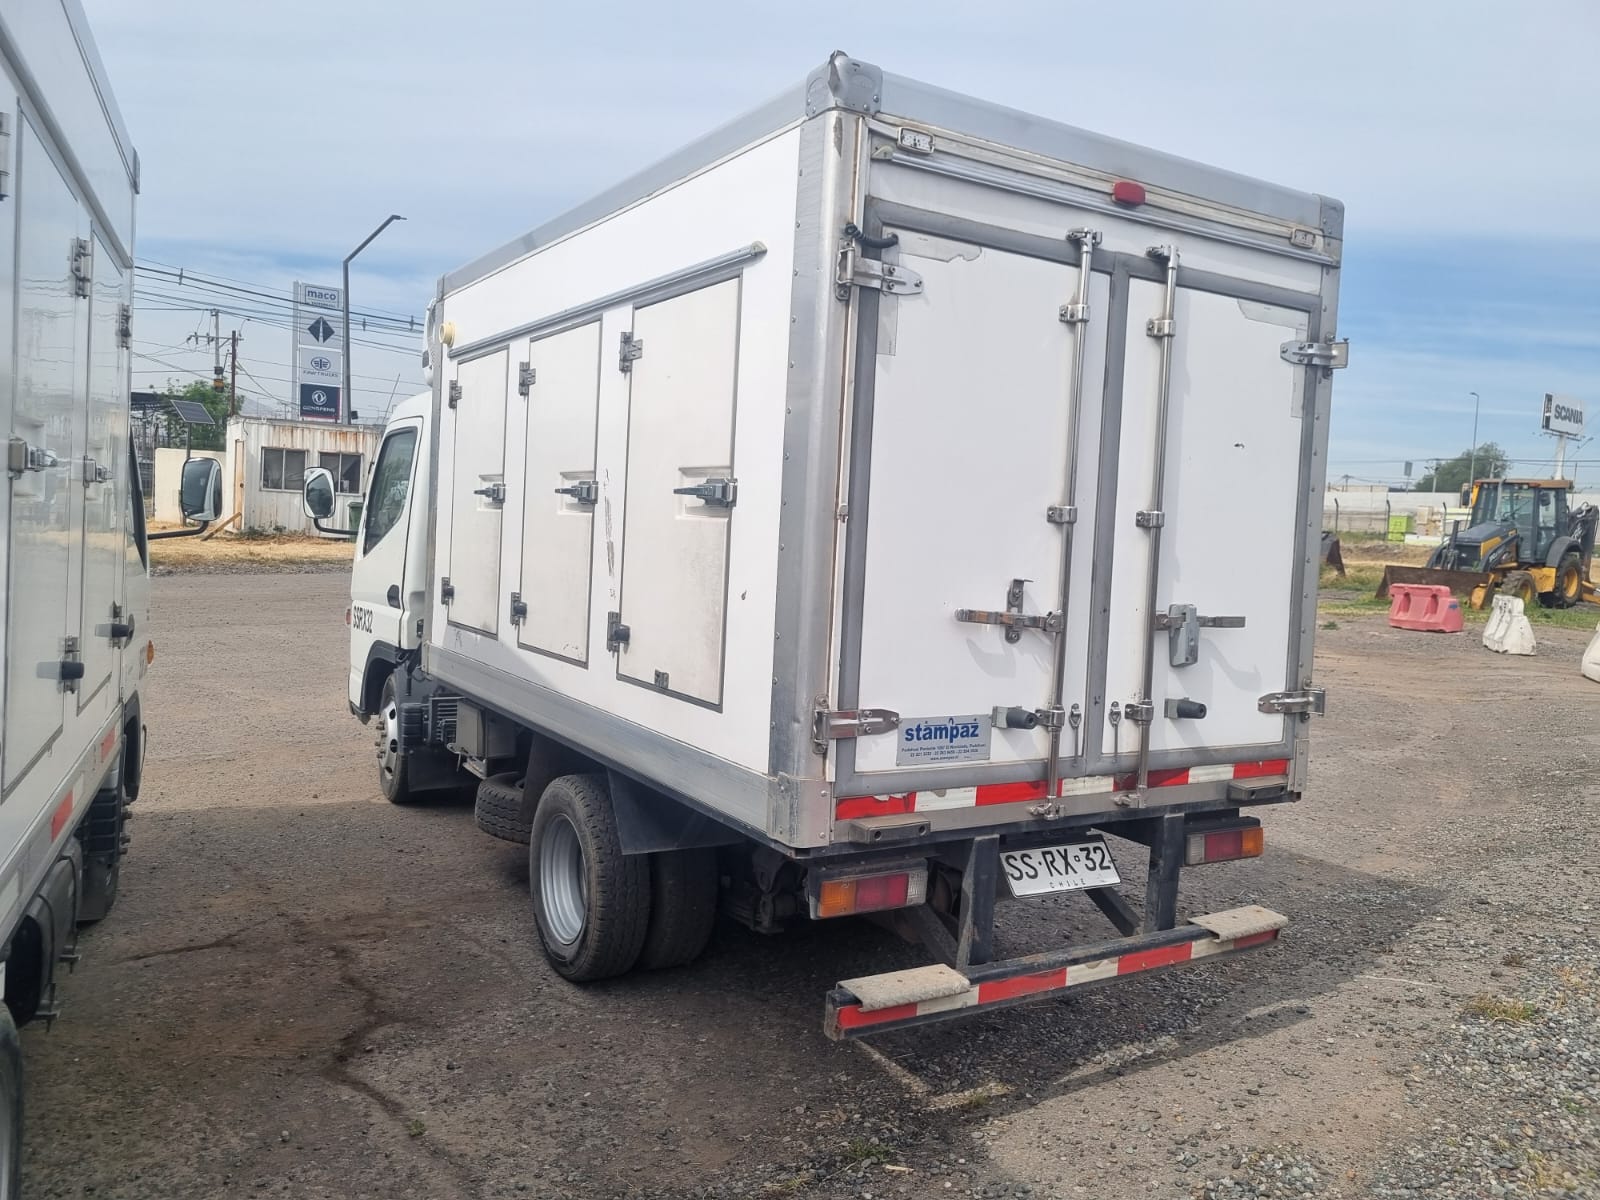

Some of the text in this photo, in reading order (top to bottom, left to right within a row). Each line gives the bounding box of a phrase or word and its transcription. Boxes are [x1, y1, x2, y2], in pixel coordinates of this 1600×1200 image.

[307, 290, 336, 301] maco
[1554, 404, 1583, 425] SCANIA
[904, 722, 979, 743] stampaz
[1049, 878, 1087, 889] CHILE
